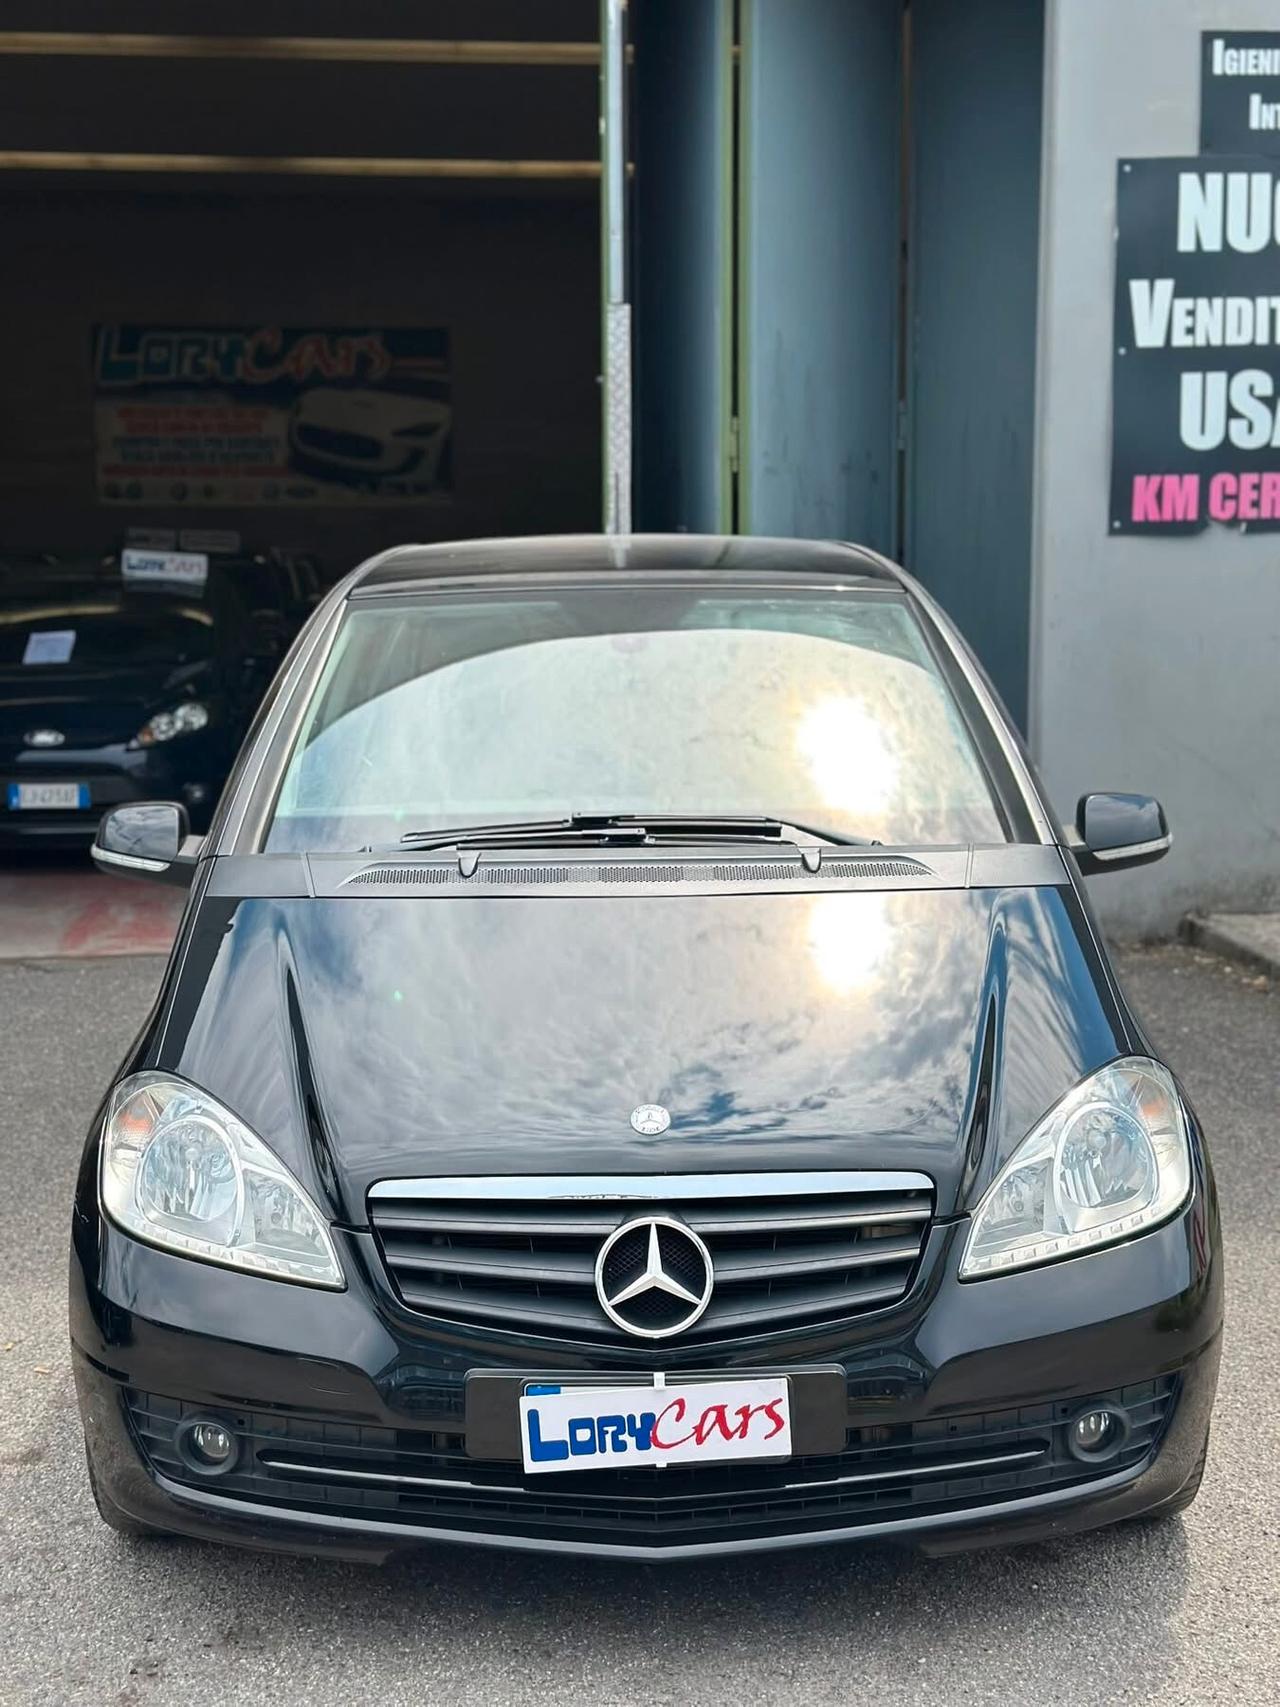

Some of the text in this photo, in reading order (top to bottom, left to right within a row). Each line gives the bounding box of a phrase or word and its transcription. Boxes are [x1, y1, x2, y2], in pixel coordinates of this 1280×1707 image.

[1177, 172, 1280, 253] NU
[1180, 369, 1280, 451] US
[1132, 472, 1280, 522] KM CER
